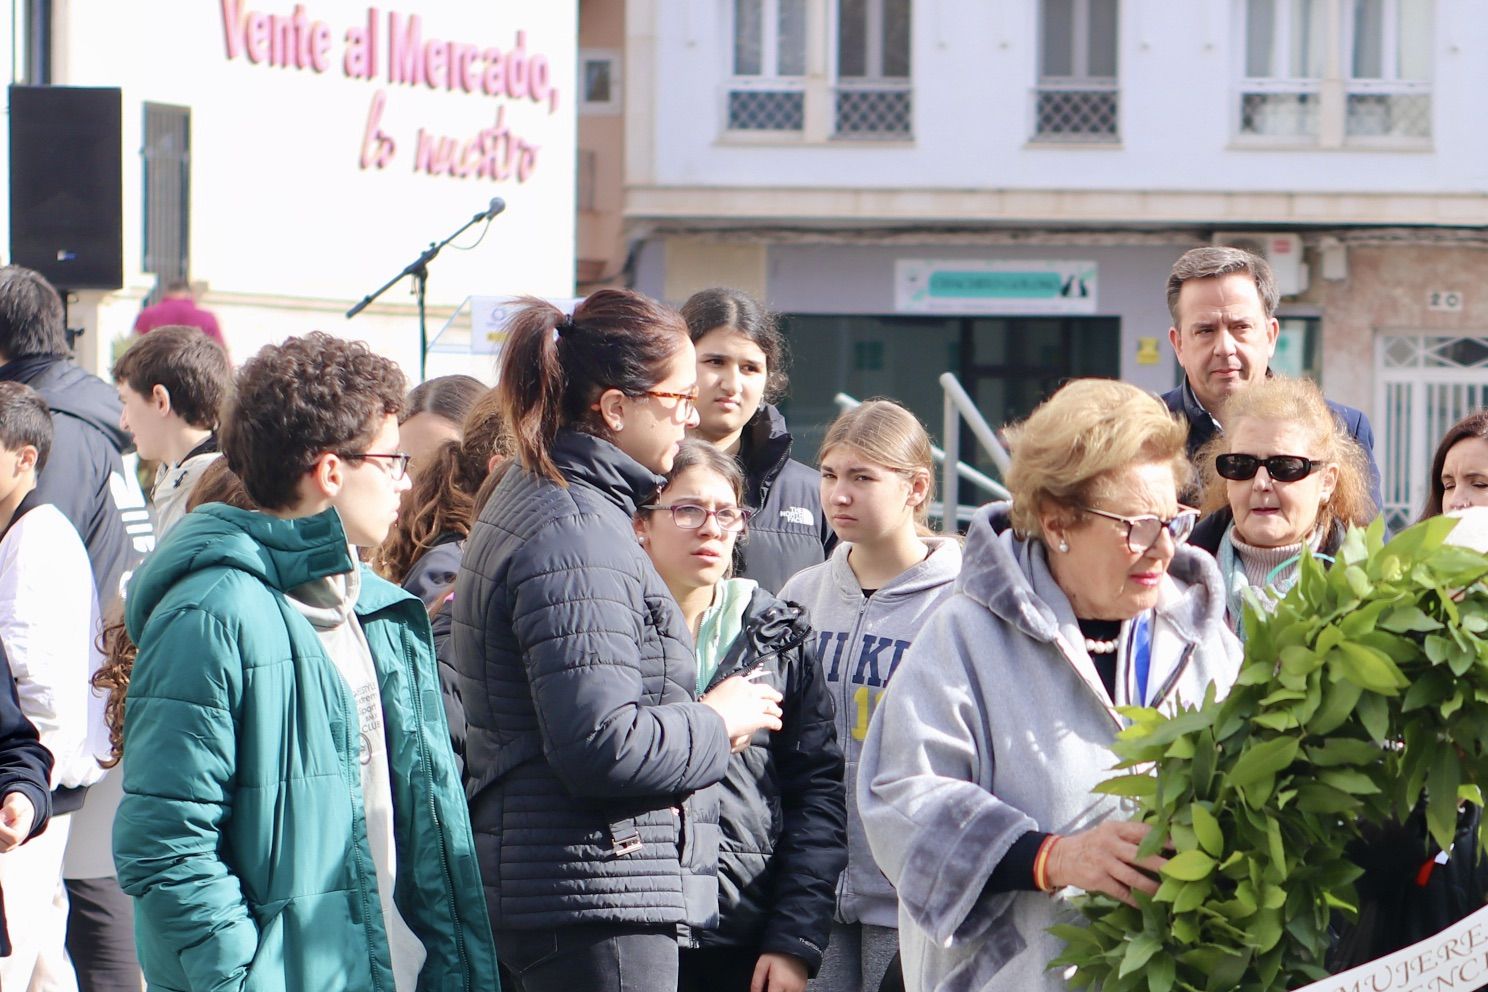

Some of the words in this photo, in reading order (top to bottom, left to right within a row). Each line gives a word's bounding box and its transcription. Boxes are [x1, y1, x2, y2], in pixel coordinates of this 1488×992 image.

[219, 0, 332, 73] Vente
[342, 7, 380, 81] al
[388, 10, 560, 115] Mercado,
[359, 88, 397, 170] lo
[413, 104, 543, 184] nuestro
[1430, 293, 1459, 308] 20
